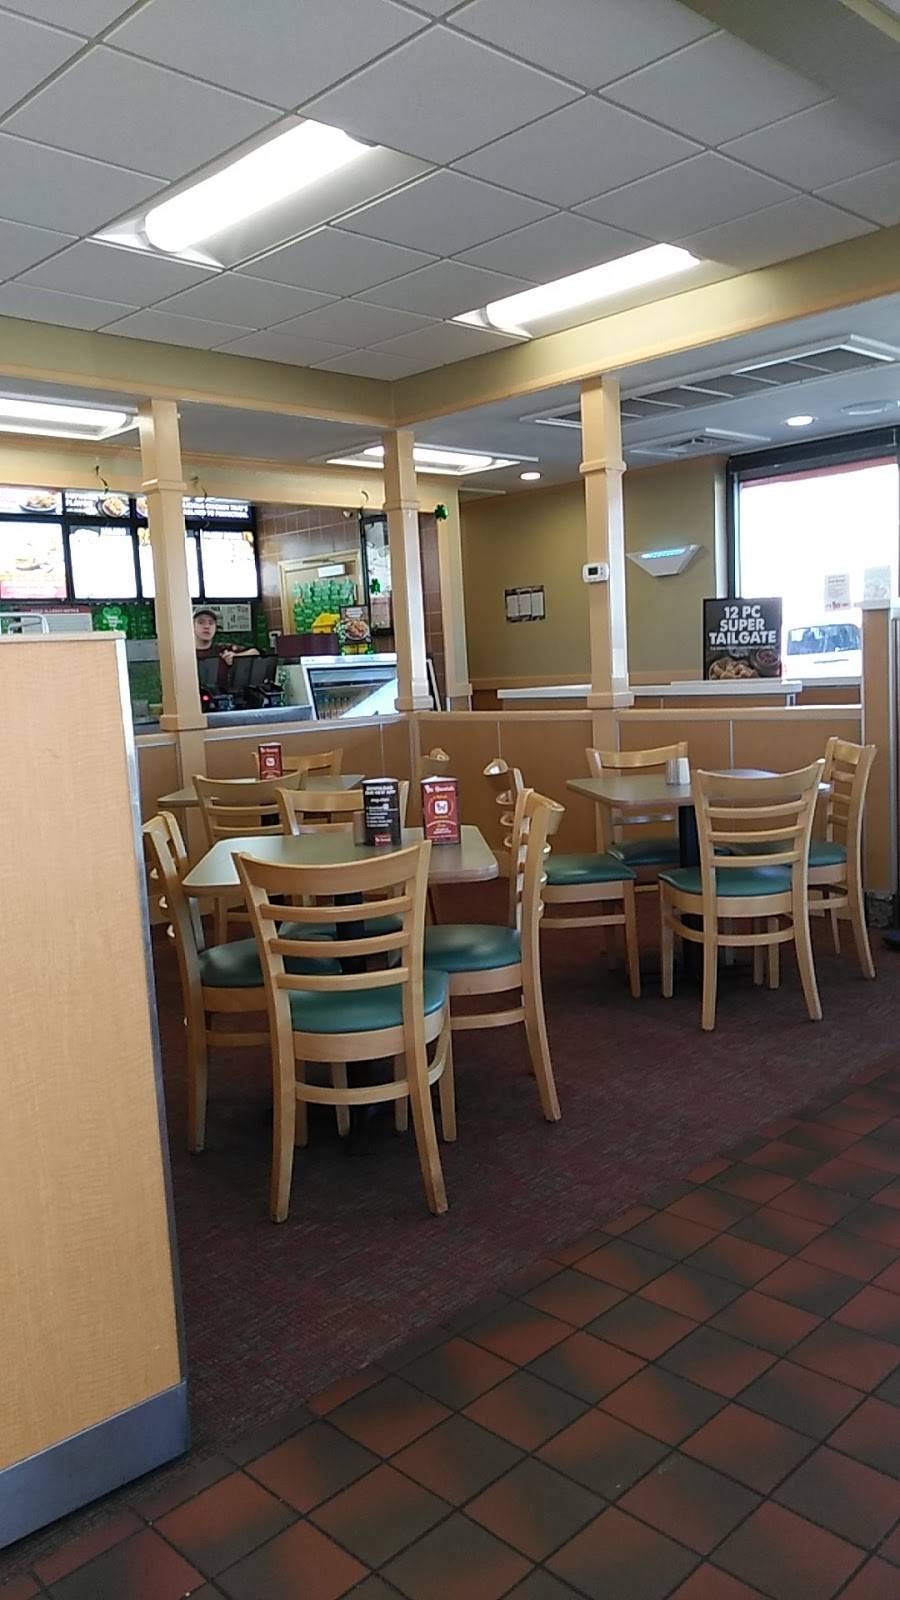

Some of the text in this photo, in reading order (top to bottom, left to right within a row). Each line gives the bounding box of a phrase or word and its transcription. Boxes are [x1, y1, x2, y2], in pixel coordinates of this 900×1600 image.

[724, 605, 761, 619] 12 PC
[720, 618, 765, 632] SUPER
[708, 630, 777, 645] TAILGATE
